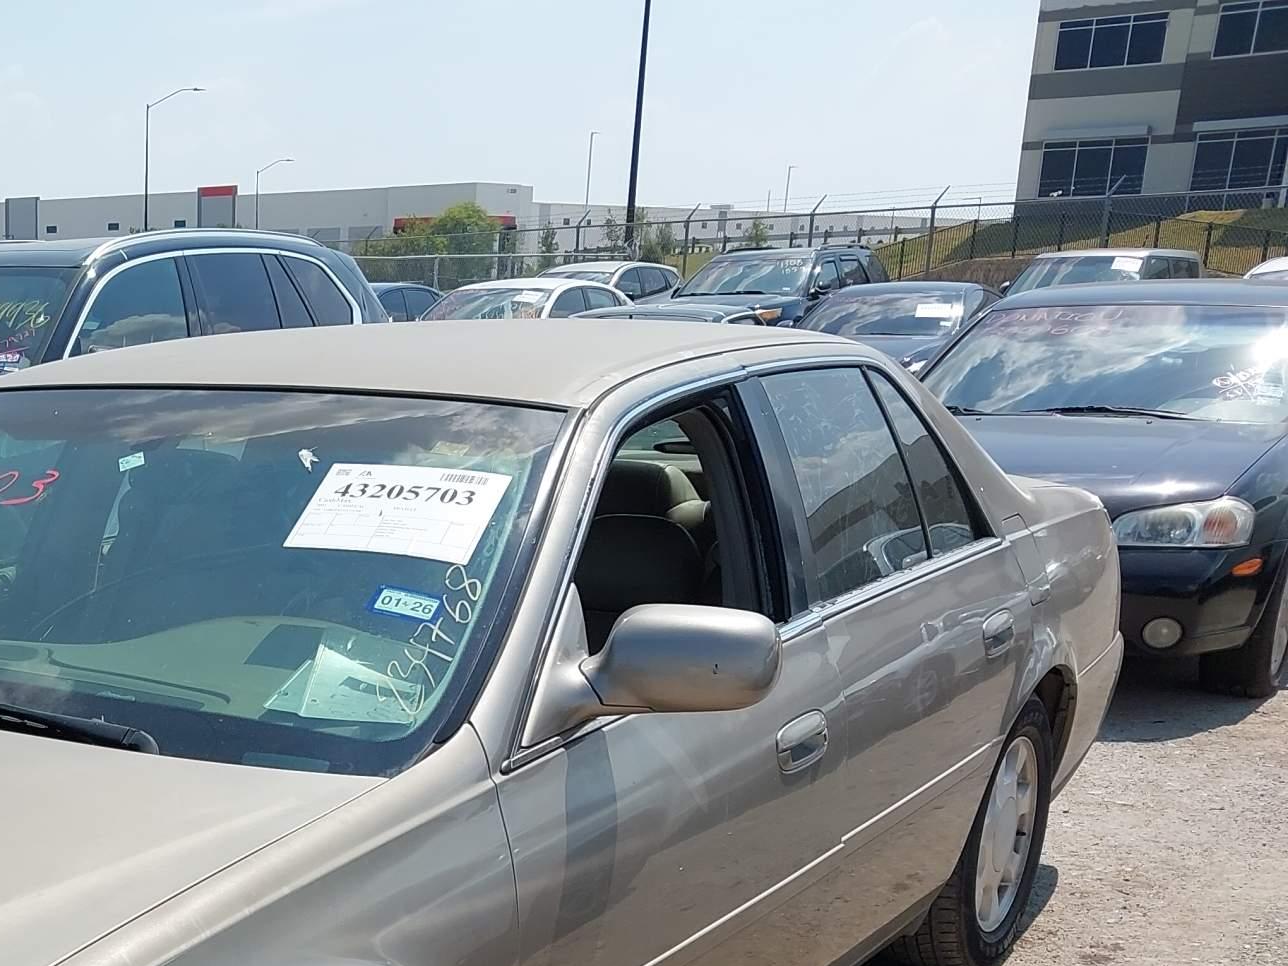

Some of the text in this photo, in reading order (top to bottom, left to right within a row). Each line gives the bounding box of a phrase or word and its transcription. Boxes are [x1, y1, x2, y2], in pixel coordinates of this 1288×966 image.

[333, 481, 477, 506] 43205703
[380, 595, 402, 608] 01
[410, 601, 435, 615] 26
